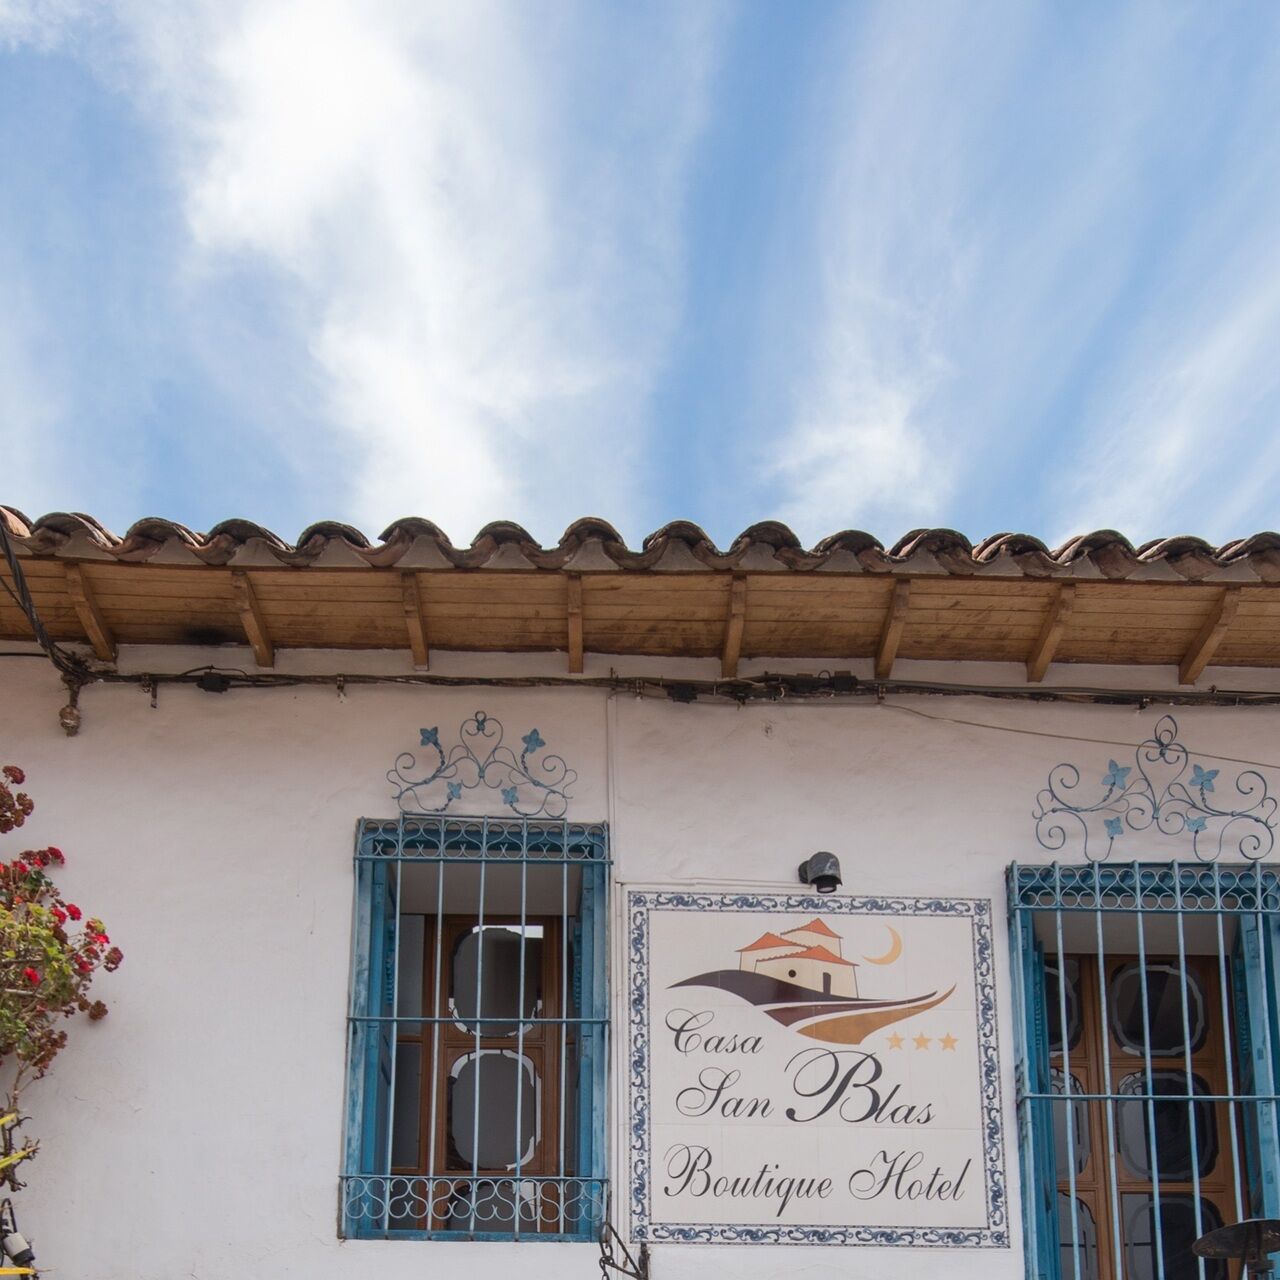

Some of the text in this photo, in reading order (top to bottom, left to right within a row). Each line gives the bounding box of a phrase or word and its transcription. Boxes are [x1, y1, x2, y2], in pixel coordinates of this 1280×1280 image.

[665, 1008, 763, 1057] Casa
[676, 1047, 935, 1125] San Blas
[663, 1143, 973, 1218] Boutique Hotel
